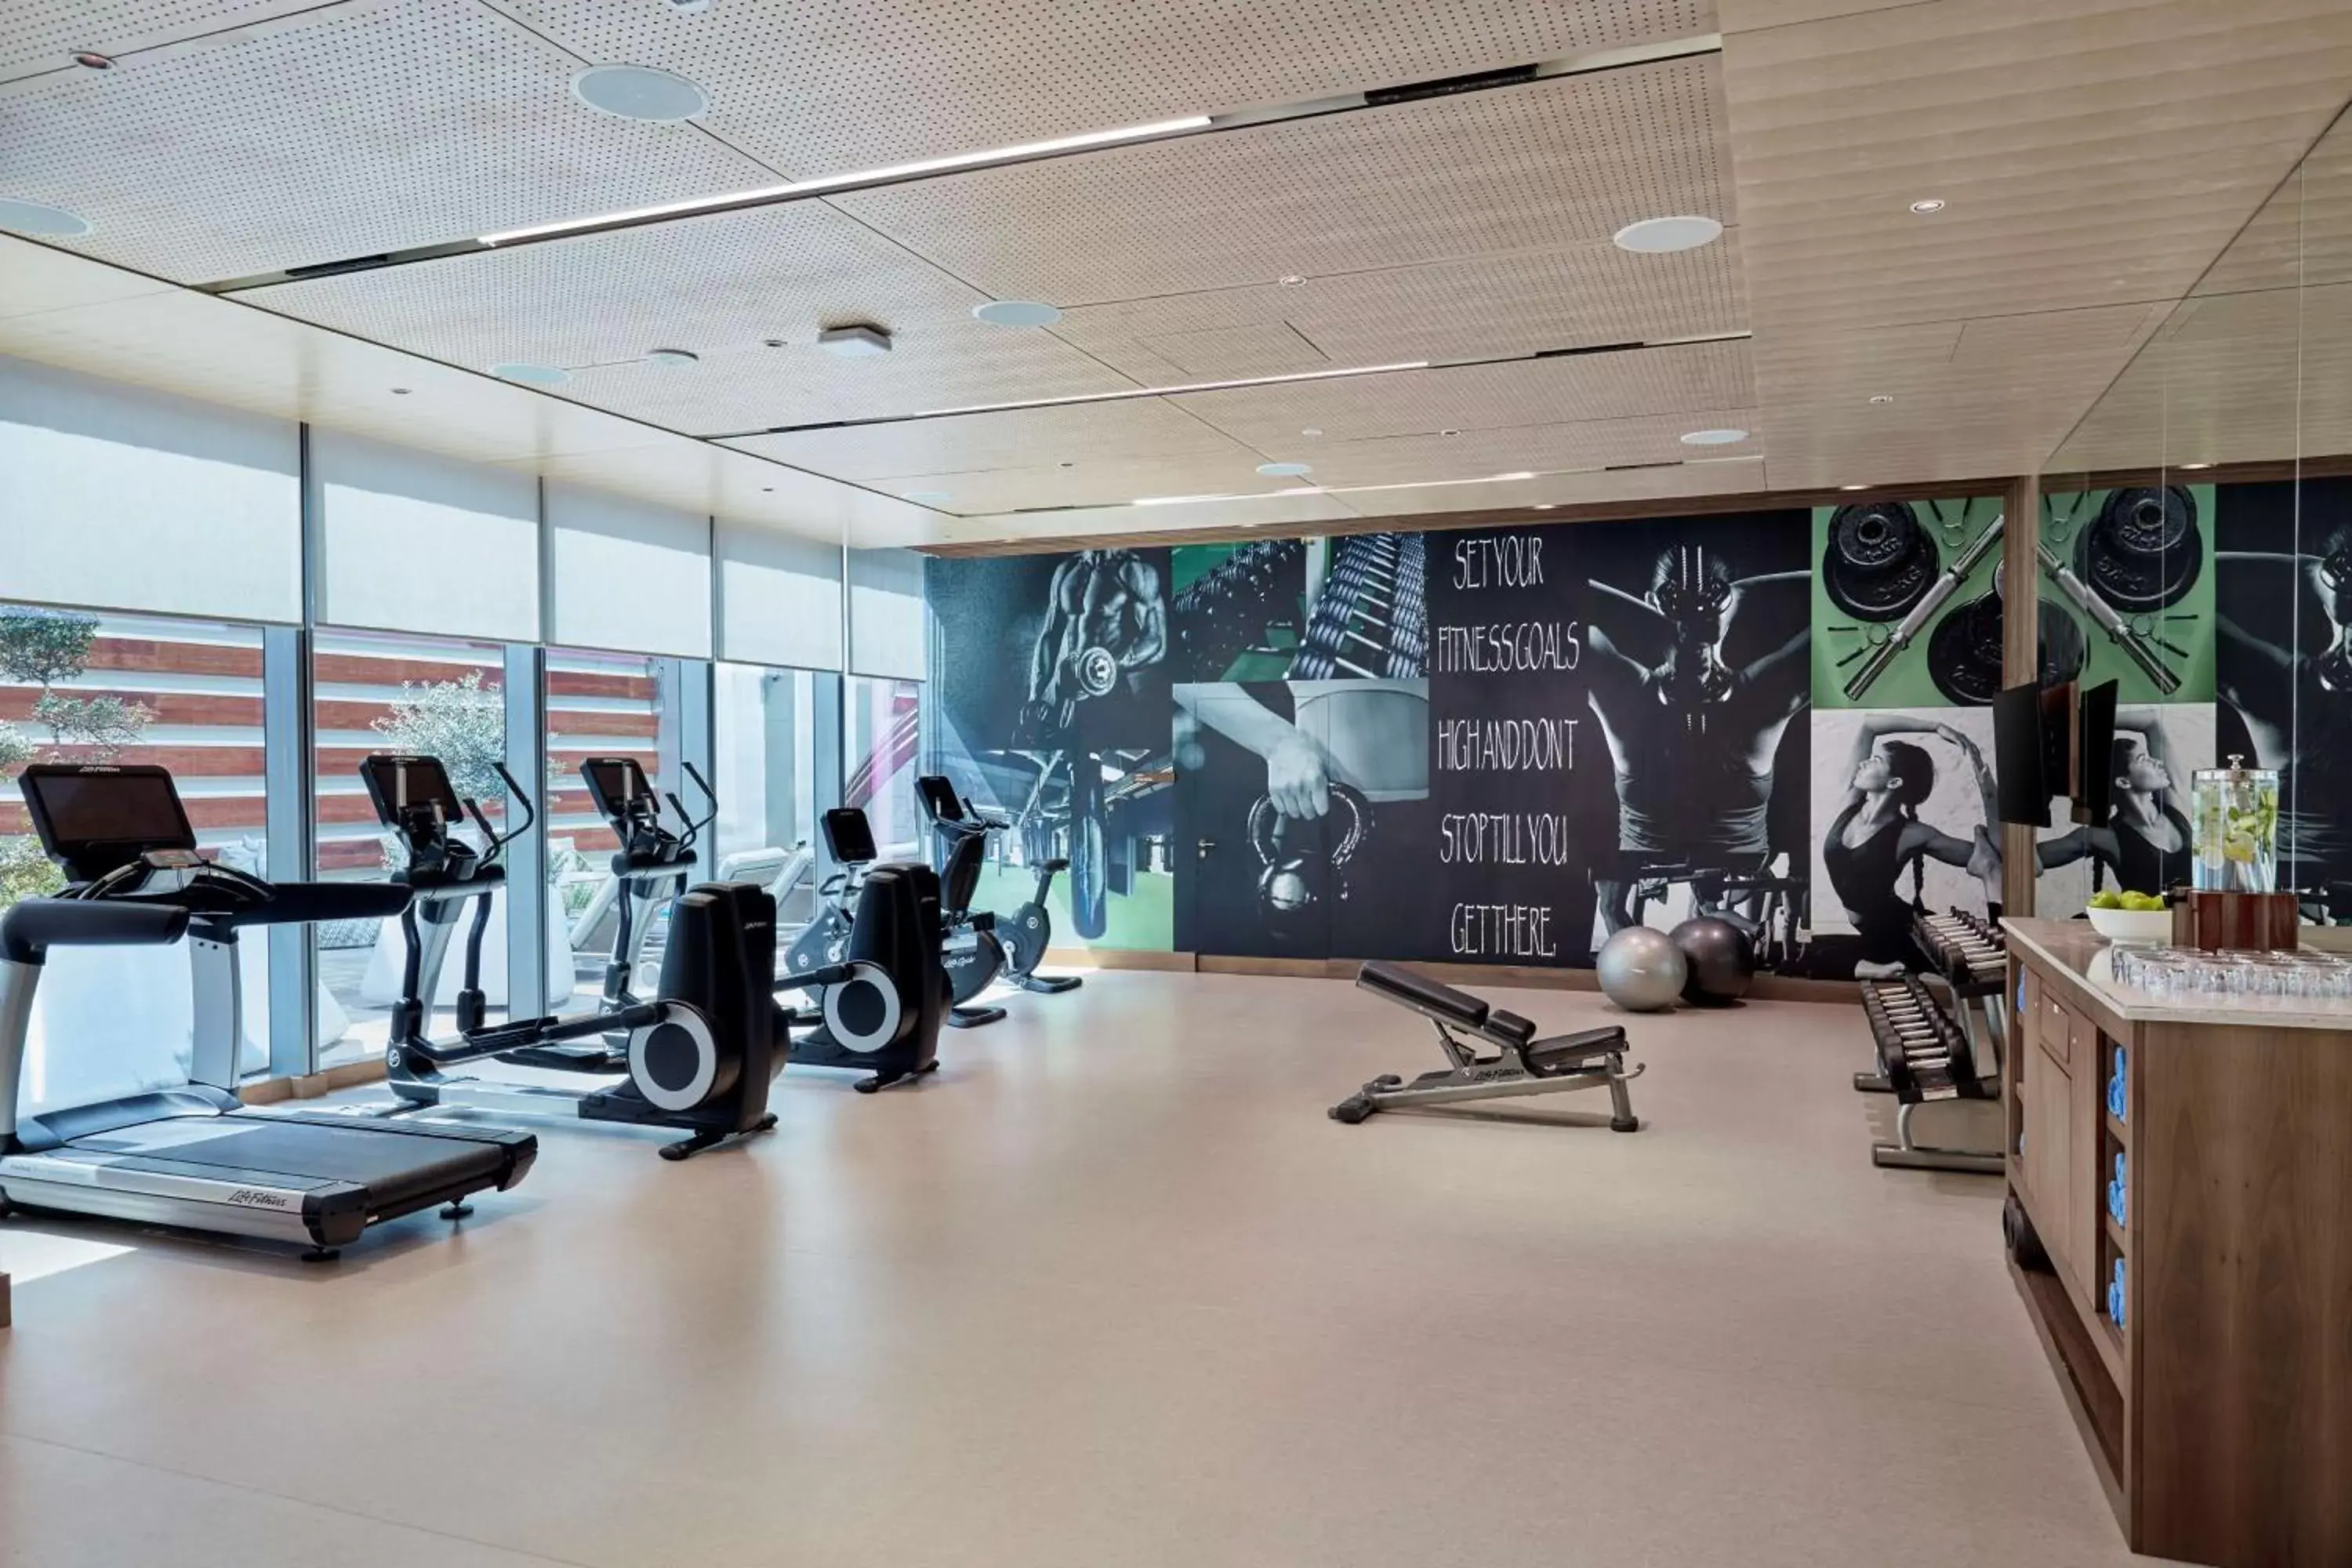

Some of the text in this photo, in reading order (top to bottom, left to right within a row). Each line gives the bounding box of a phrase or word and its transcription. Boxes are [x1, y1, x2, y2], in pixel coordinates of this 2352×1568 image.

[1453, 535, 1544, 590] SET YOUR
[1439, 622, 1580, 672] FITNESS GOALS
[1439, 717, 1578, 770] HIGH AND DONT
[1440, 813, 1567, 866] STOP TILL YOU
[1451, 903, 1556, 956] GET THERE
